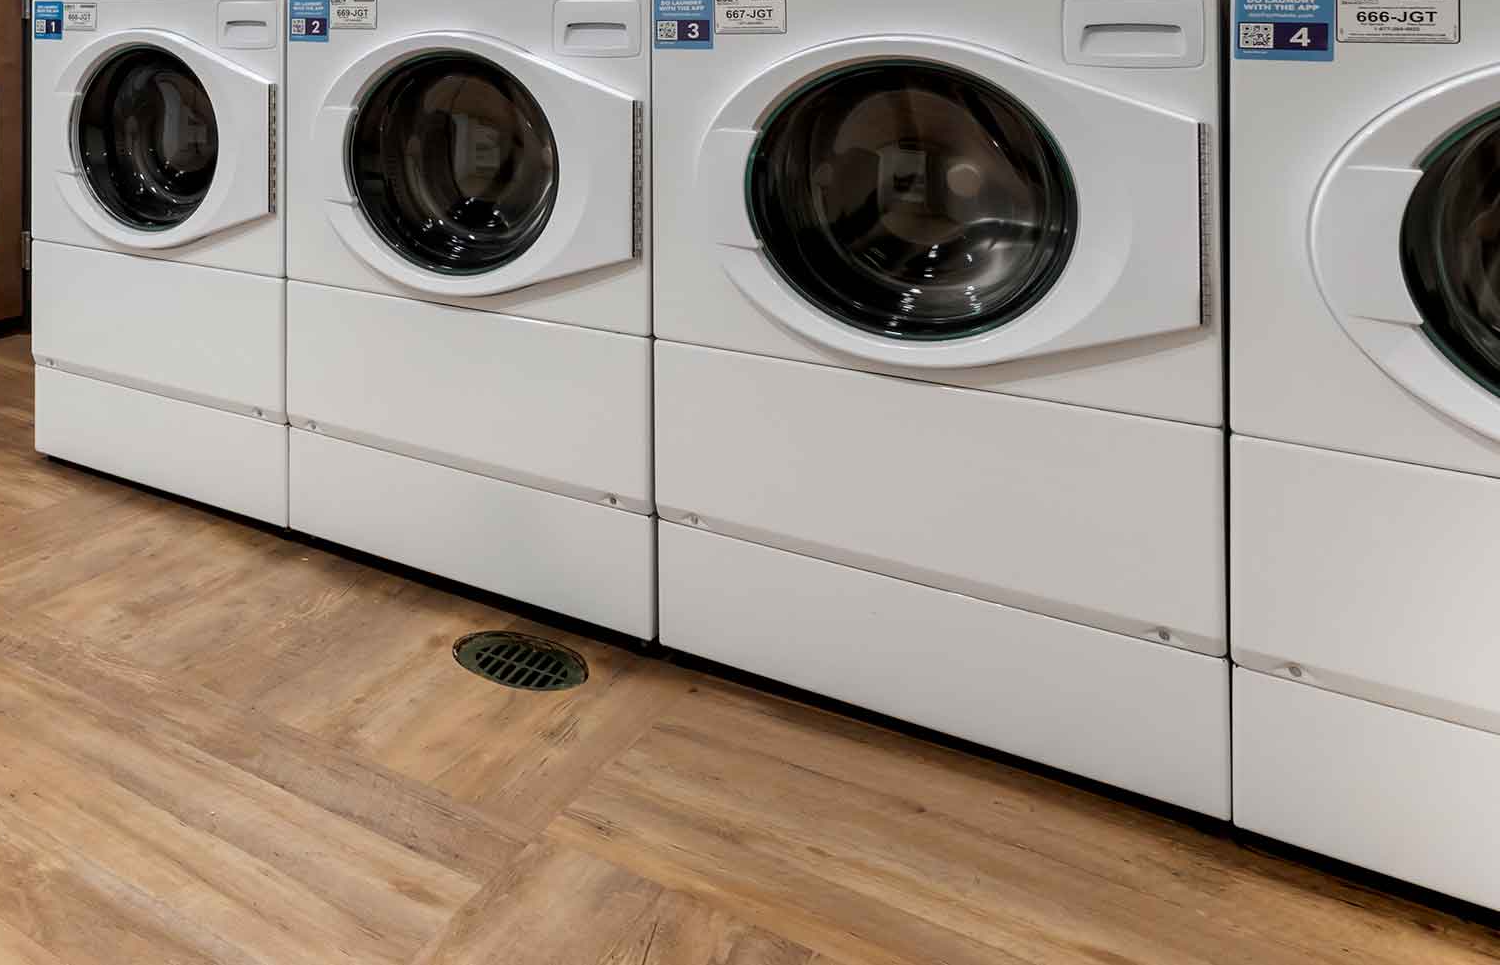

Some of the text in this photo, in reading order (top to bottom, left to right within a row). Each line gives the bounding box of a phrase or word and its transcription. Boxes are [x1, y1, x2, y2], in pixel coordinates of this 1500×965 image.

[1297, 3, 1320, 11] APP
[726, 9, 773, 19] 667-JGT
[1356, 11, 1438, 23] 666-JGT
[50, 21, 56, 33] 1
[311, 20, 320, 33] 2
[687, 23, 699, 38] 3
[1289, 26, 1311, 47] 4
